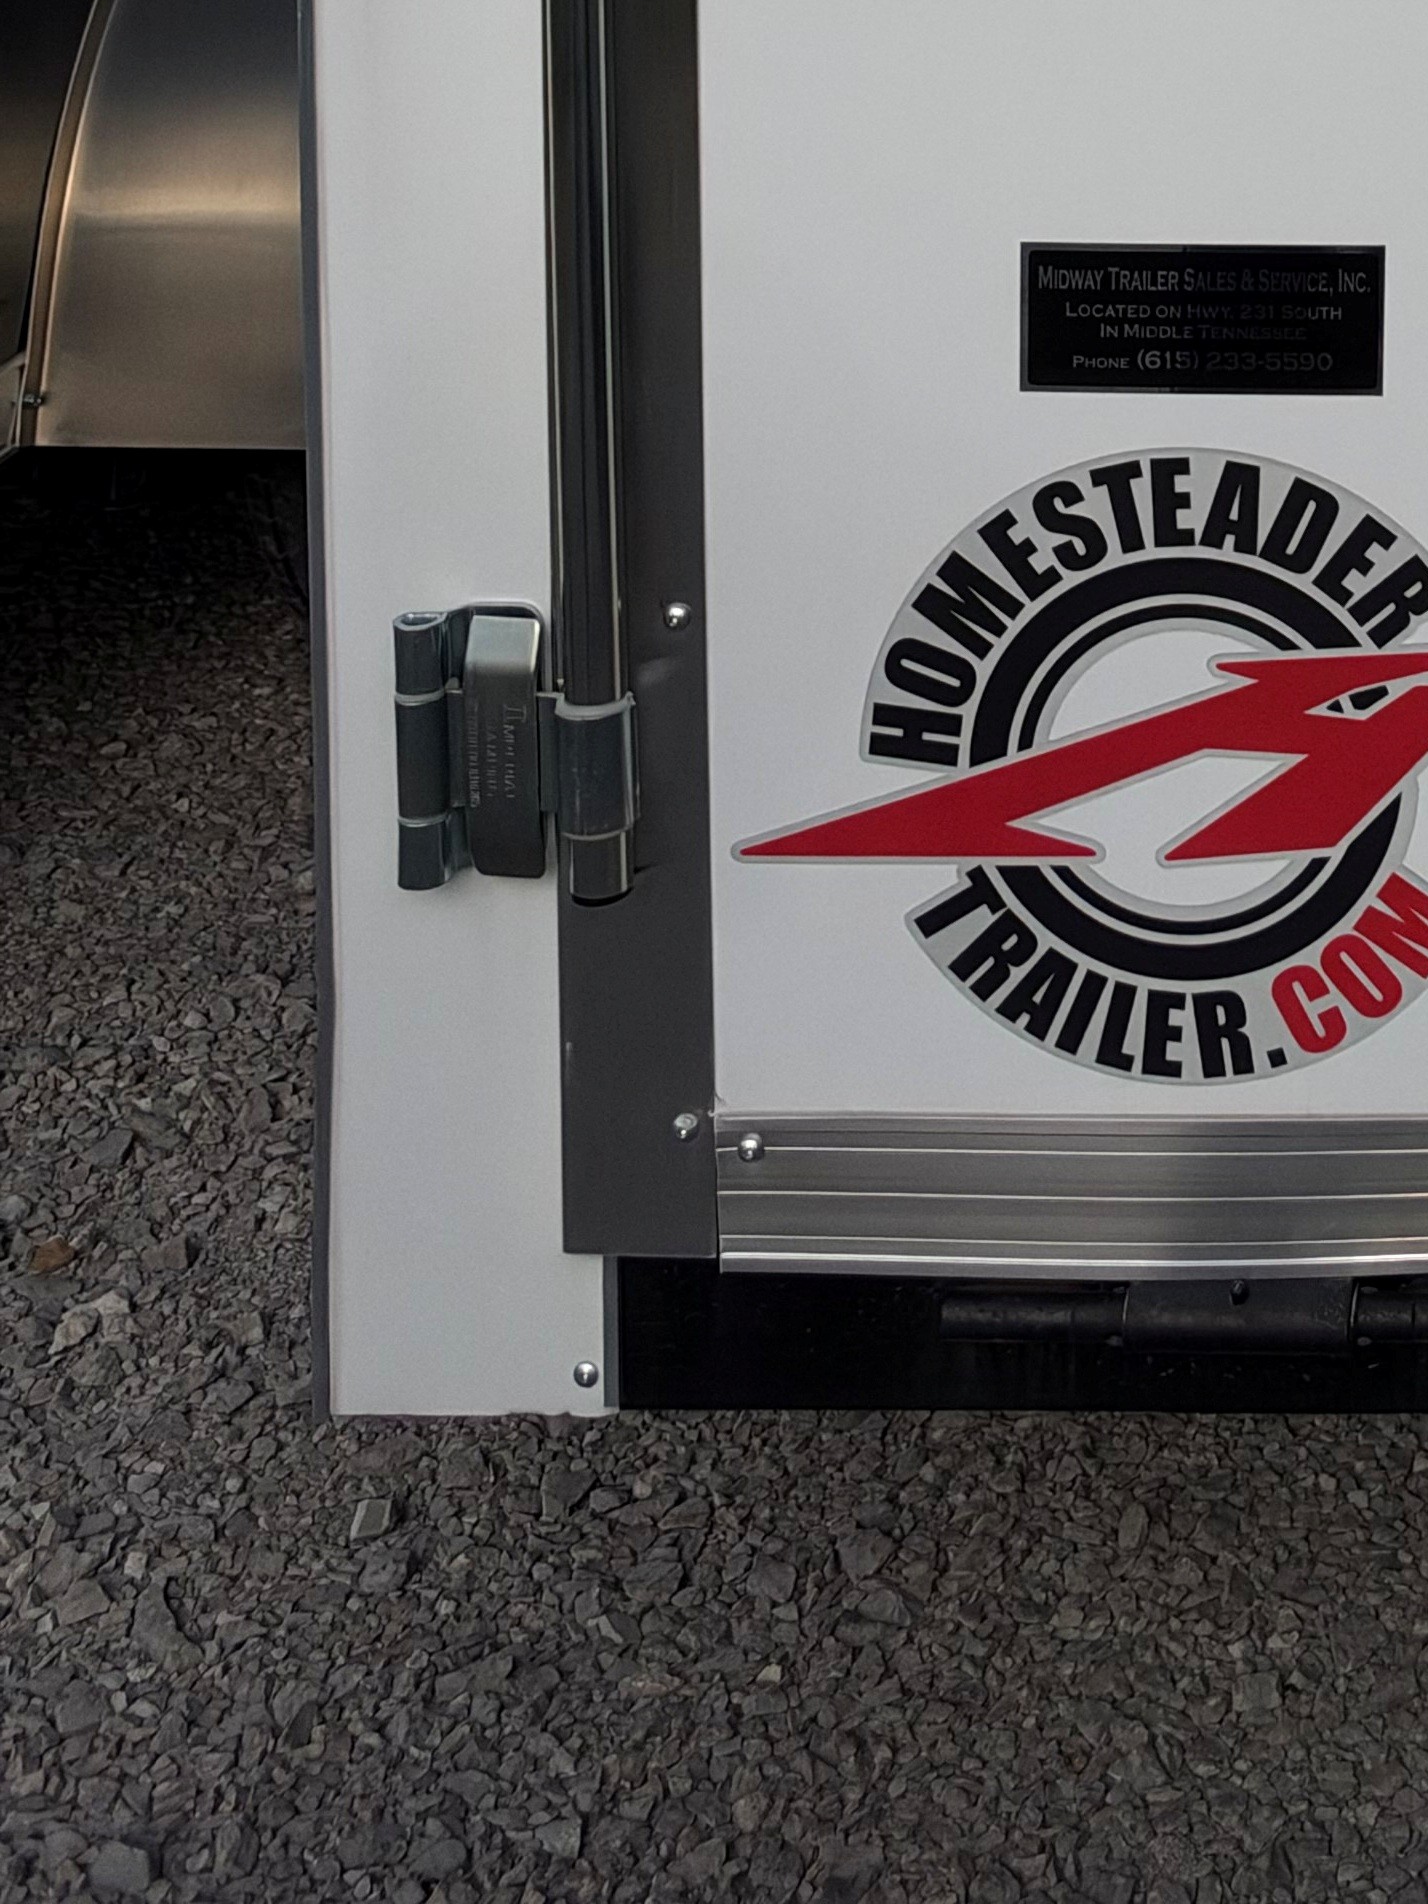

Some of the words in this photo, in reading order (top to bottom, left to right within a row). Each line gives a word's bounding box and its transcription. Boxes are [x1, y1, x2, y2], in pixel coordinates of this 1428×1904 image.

[1038, 265, 1104, 290] MIDWAY
[1108, 267, 1179, 292] TRAILER
[1183, 268, 1237, 292] SALES
[1241, 269, 1254, 292] &
[1258, 269, 1334, 297] SERVICE,
[1338, 269, 1371, 293] INC.
[1065, 301, 1151, 319] LOCATED
[1155, 305, 1182, 319] ON
[1239, 304, 1275, 319] 231
[1282, 305, 1342, 321] SOUTH
[1100, 323, 1119, 339] IN
[1123, 324, 1194, 340] MIDDLE
[1199, 325, 1307, 341] TENNESSEE
[1072, 355, 1130, 369] PHONE
[1137, 348, 1199, 371] (615)
[1206, 351, 1333, 372] 233-5590
